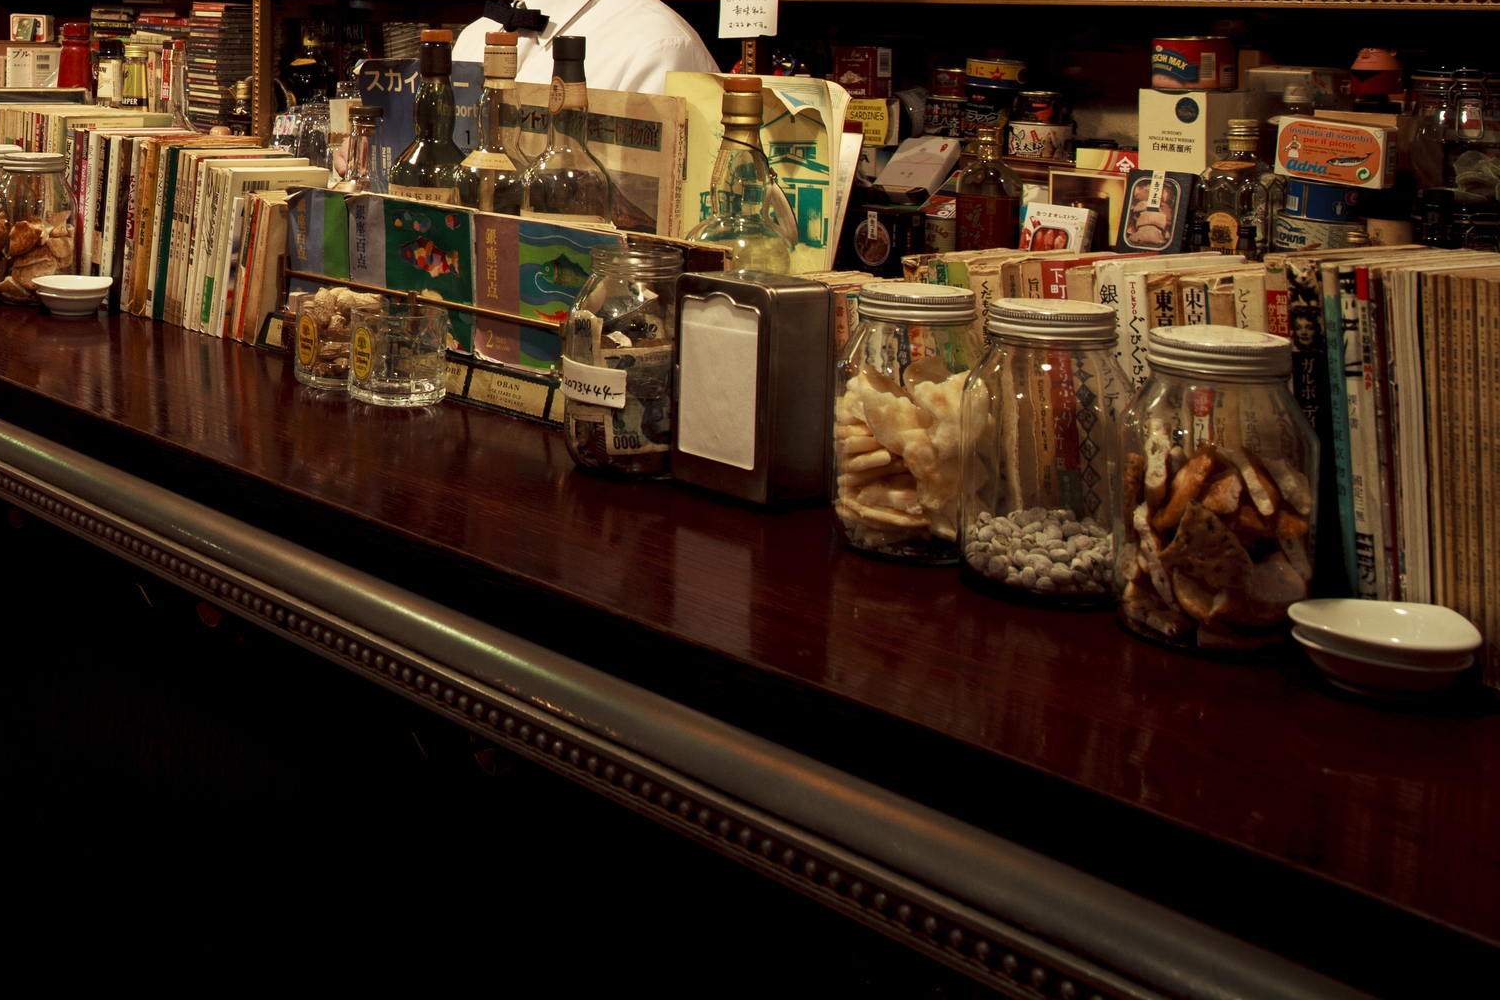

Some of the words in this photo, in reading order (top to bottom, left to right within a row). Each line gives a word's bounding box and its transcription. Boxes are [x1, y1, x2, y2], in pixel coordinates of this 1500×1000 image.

[850, 111, 885, 121] SARDINES
[1152, 142, 1192, 154] 白州蒸溜所
[1289, 126, 1323, 138] insalata
[1325, 131, 1334, 139] di
[1336, 132, 1373, 143] scombri
[1303, 138, 1318, 146] per
[1320, 137, 1327, 145] il
[1329, 140, 1356, 150] picnic
[355, 205, 368, 270] 銀座百点
[486, 228, 498, 299] 銀座百点
[1050, 268, 1067, 299] 下町
[1154, 290, 1175, 327] 東京
[1268, 304, 1277, 333] からの
[1276, 294, 1288, 334] 知識ゼロ
[486, 330, 494, 349] 2
[497, 380, 521, 391] OBAN
[1301, 358, 1316, 399] ガルボ
